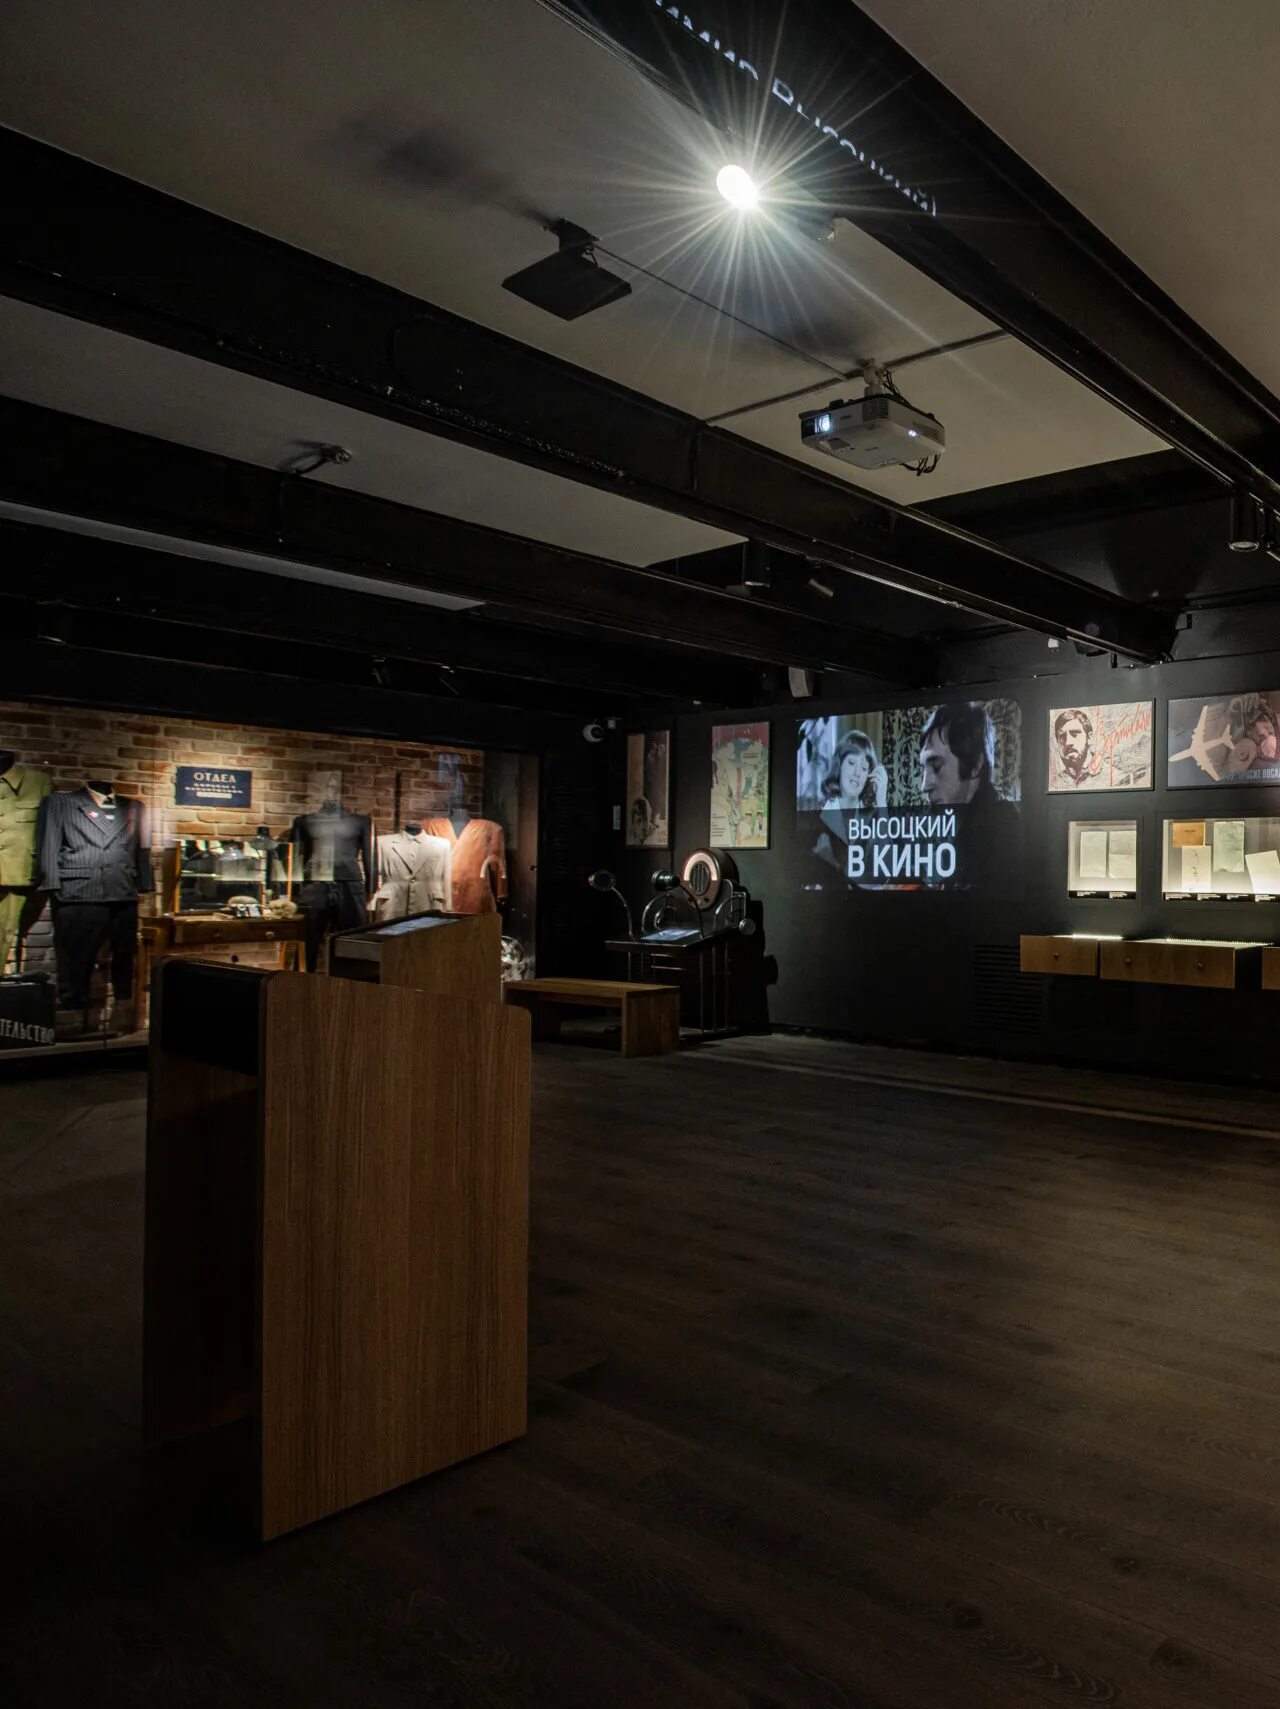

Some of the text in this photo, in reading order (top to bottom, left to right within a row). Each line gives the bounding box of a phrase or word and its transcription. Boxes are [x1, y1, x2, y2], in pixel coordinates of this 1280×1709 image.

[193, 771, 237, 783] ОТДЕЛ
[848, 808, 956, 841] ВЫСОЦКИЙ
[847, 842, 956, 877] В КИНО
